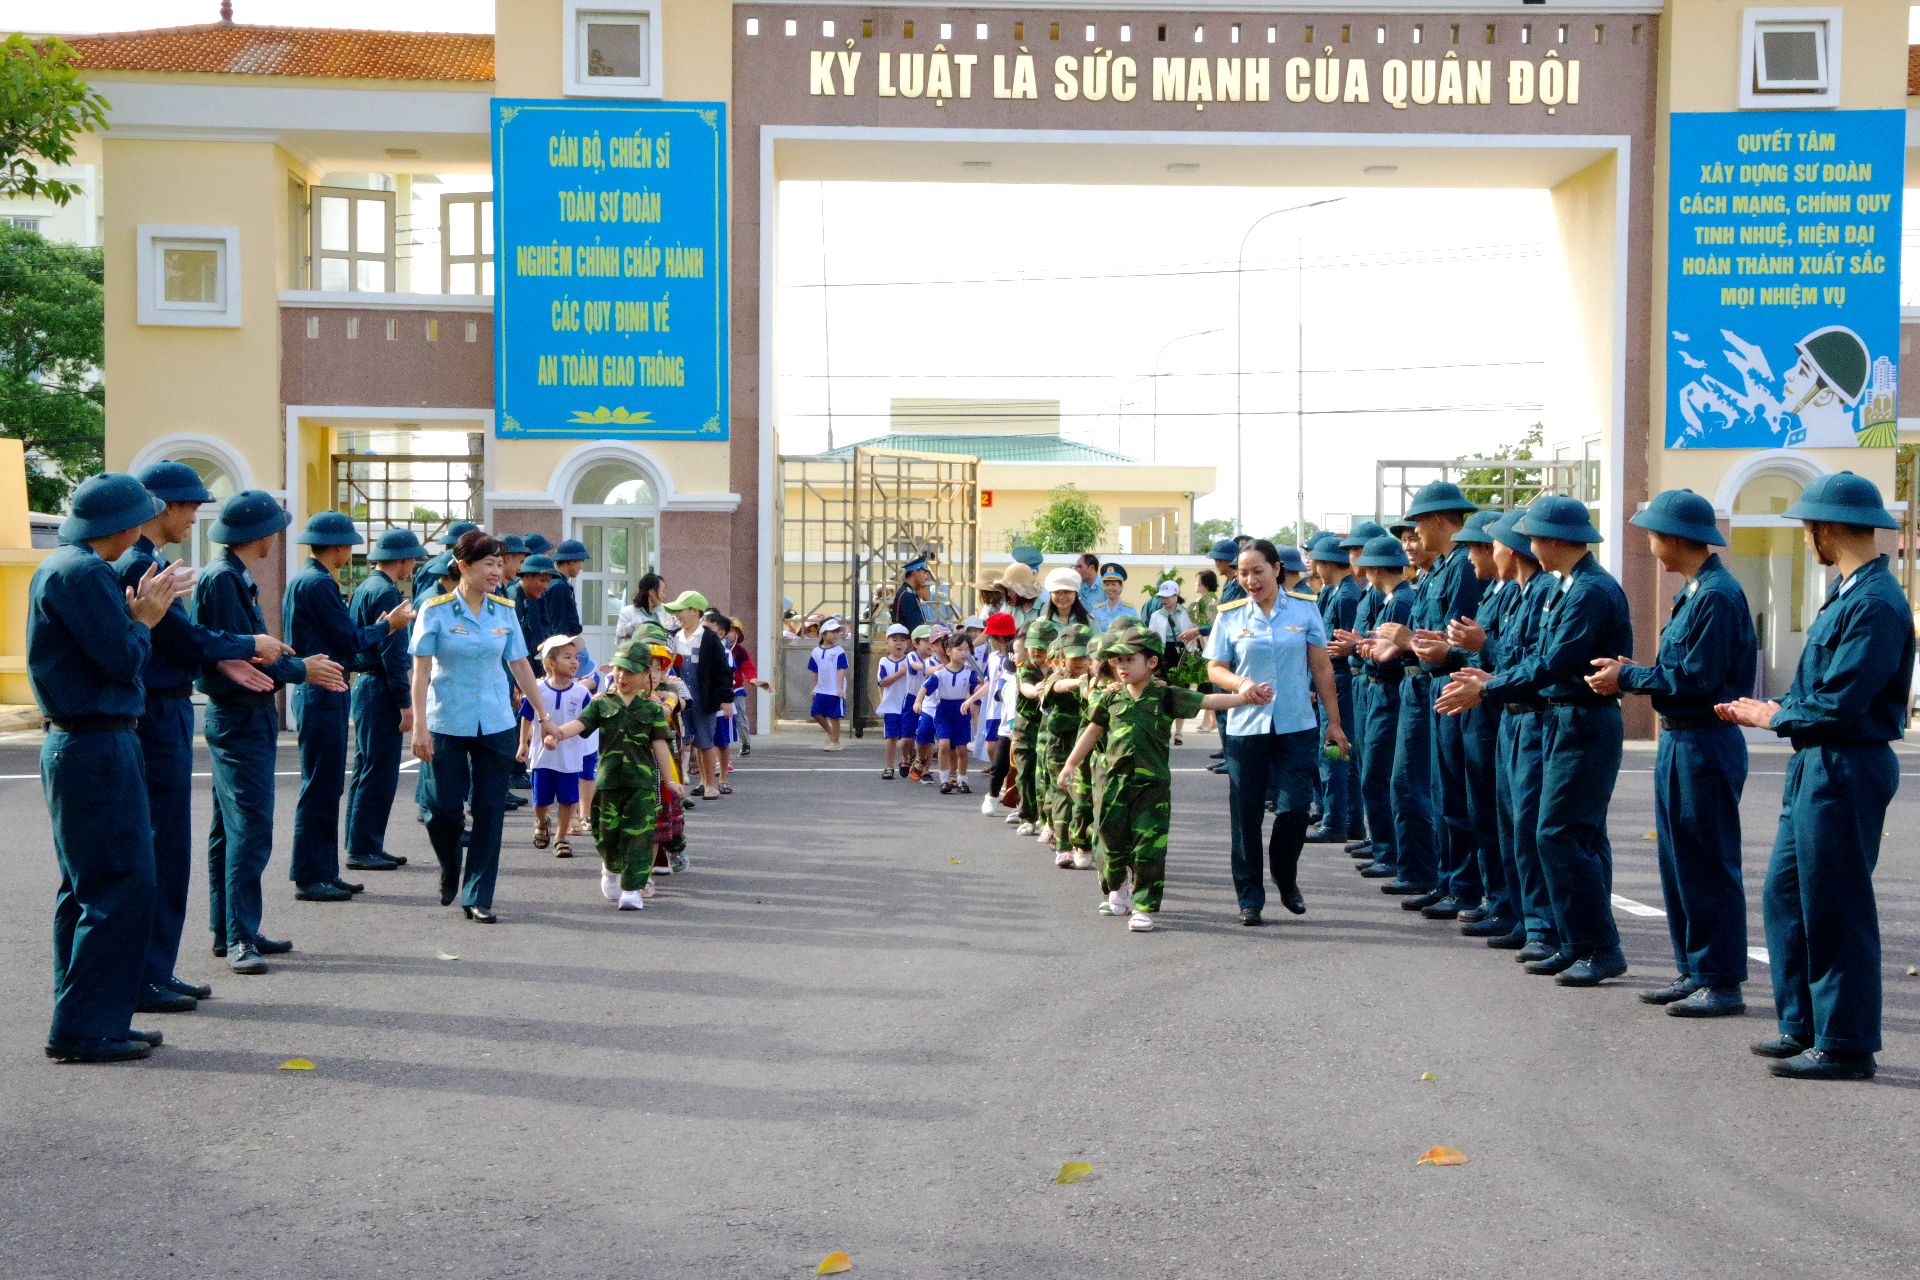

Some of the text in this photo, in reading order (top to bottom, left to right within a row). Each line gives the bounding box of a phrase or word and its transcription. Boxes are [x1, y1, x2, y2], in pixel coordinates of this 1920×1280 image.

[810, 38, 1580, 115] KỶ LUẬT LÀ SỨC MẠNH CỦA QUÂN ĐỘI
[549, 127, 671, 175] CÁN BỘ, CHIẾN SĨ
[1737, 127, 1836, 155] QUYẾT TÂM
[1700, 159, 1873, 187] XÂY DỰNG SƯ ĐOÀN
[558, 185, 662, 224] TOÀN SƯ ĐOÀN
[1680, 191, 1892, 218] CÁCH MẠNG, CHÍNH QUY
[1694, 221, 1875, 248] TINH NHUỆ, HIỆN ĐẠI
[516, 235, 704, 279] NGHIÊM CHỈNH CHẤP HÀNH
[1682, 248, 1886, 276] HOÀN THÀNH XUẤT SẮC
[1720, 283, 1846, 310] MỌI NHIỆM VỤ
[551, 293, 581, 332] CÁC
[583, 300, 612, 335] QUY
[614, 300, 650, 339] ĐỊNH
[537, 348, 685, 388] AN TOÀN GIAO THÔNG
